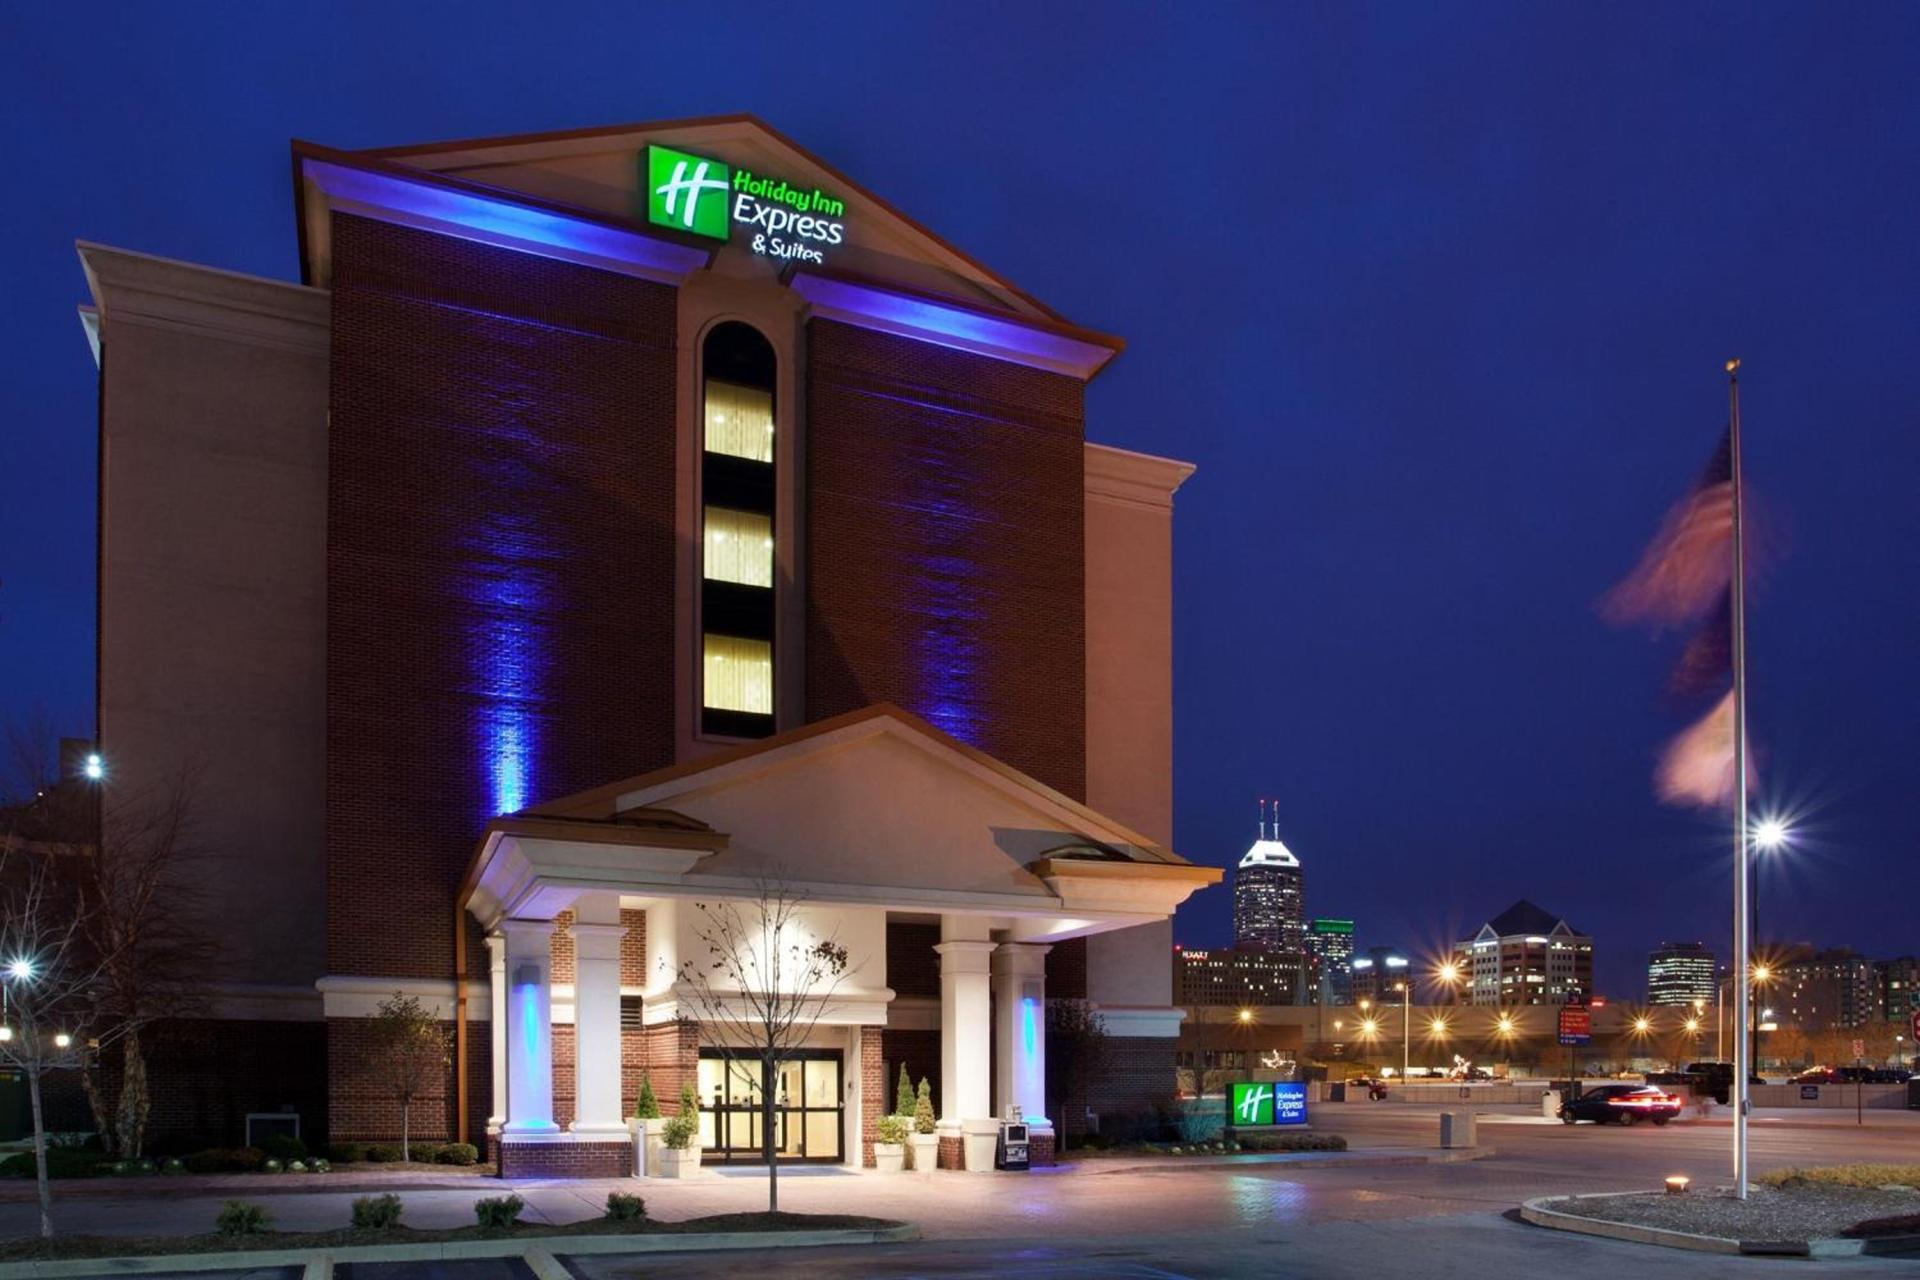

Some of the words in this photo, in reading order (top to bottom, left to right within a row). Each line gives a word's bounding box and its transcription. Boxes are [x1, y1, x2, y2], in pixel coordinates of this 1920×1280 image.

[733, 170, 809, 212] Holiday
[812, 189, 845, 217] Inn
[733, 194, 844, 245] Express
[752, 233, 767, 255] &
[769, 238, 823, 265] Suites
